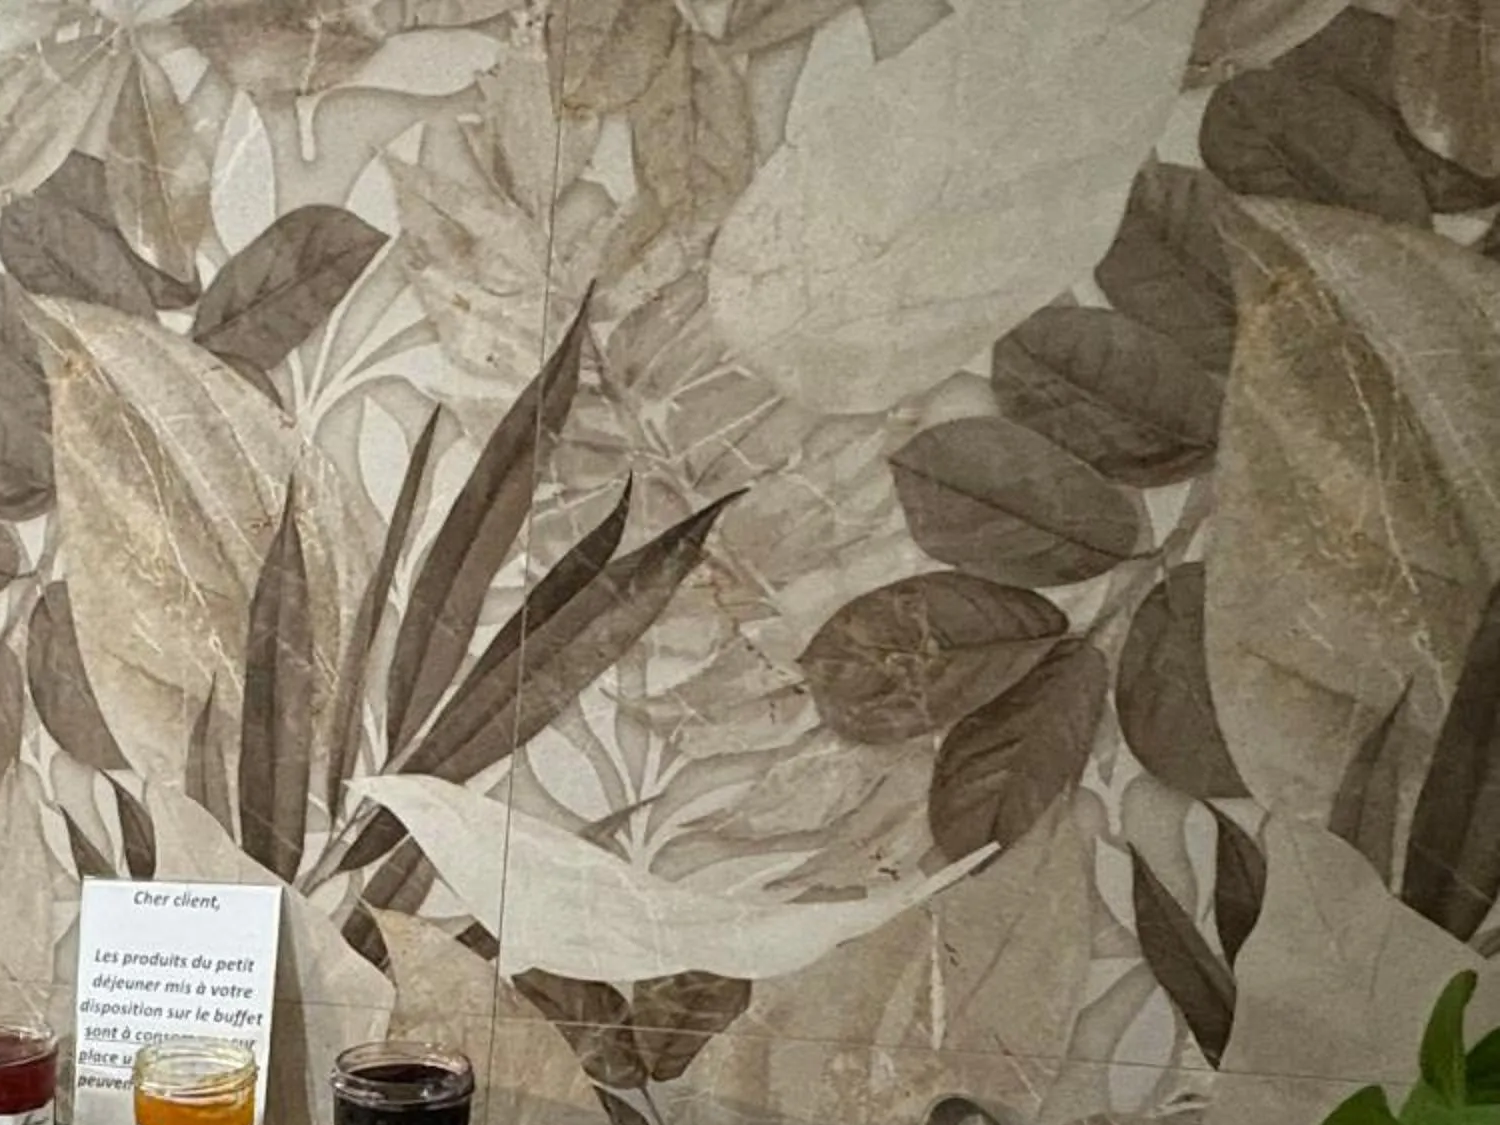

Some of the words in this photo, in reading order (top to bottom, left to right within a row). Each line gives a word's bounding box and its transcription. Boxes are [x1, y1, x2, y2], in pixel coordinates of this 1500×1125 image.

[133, 890, 170, 907] Cher
[173, 891, 221, 912] client,
[94, 949, 119, 964] Les
[122, 950, 188, 969] produits
[191, 955, 212, 970] du
[215, 957, 255, 974] petit
[92, 974, 162, 996] déjeuner
[164, 979, 192, 995] mis
[195, 979, 206, 995] à
[210, 982, 254, 999] votre
[80, 999, 163, 1019] disposition
[166, 1005, 192, 1020] sur
[195, 1005, 211, 1021] le
[213, 1008, 264, 1027] buffet
[84, 1025, 119, 1039] sont
[121, 1024, 132, 1040] à
[78, 1048, 119, 1066] place
[77, 1074, 134, 1091] peuven
